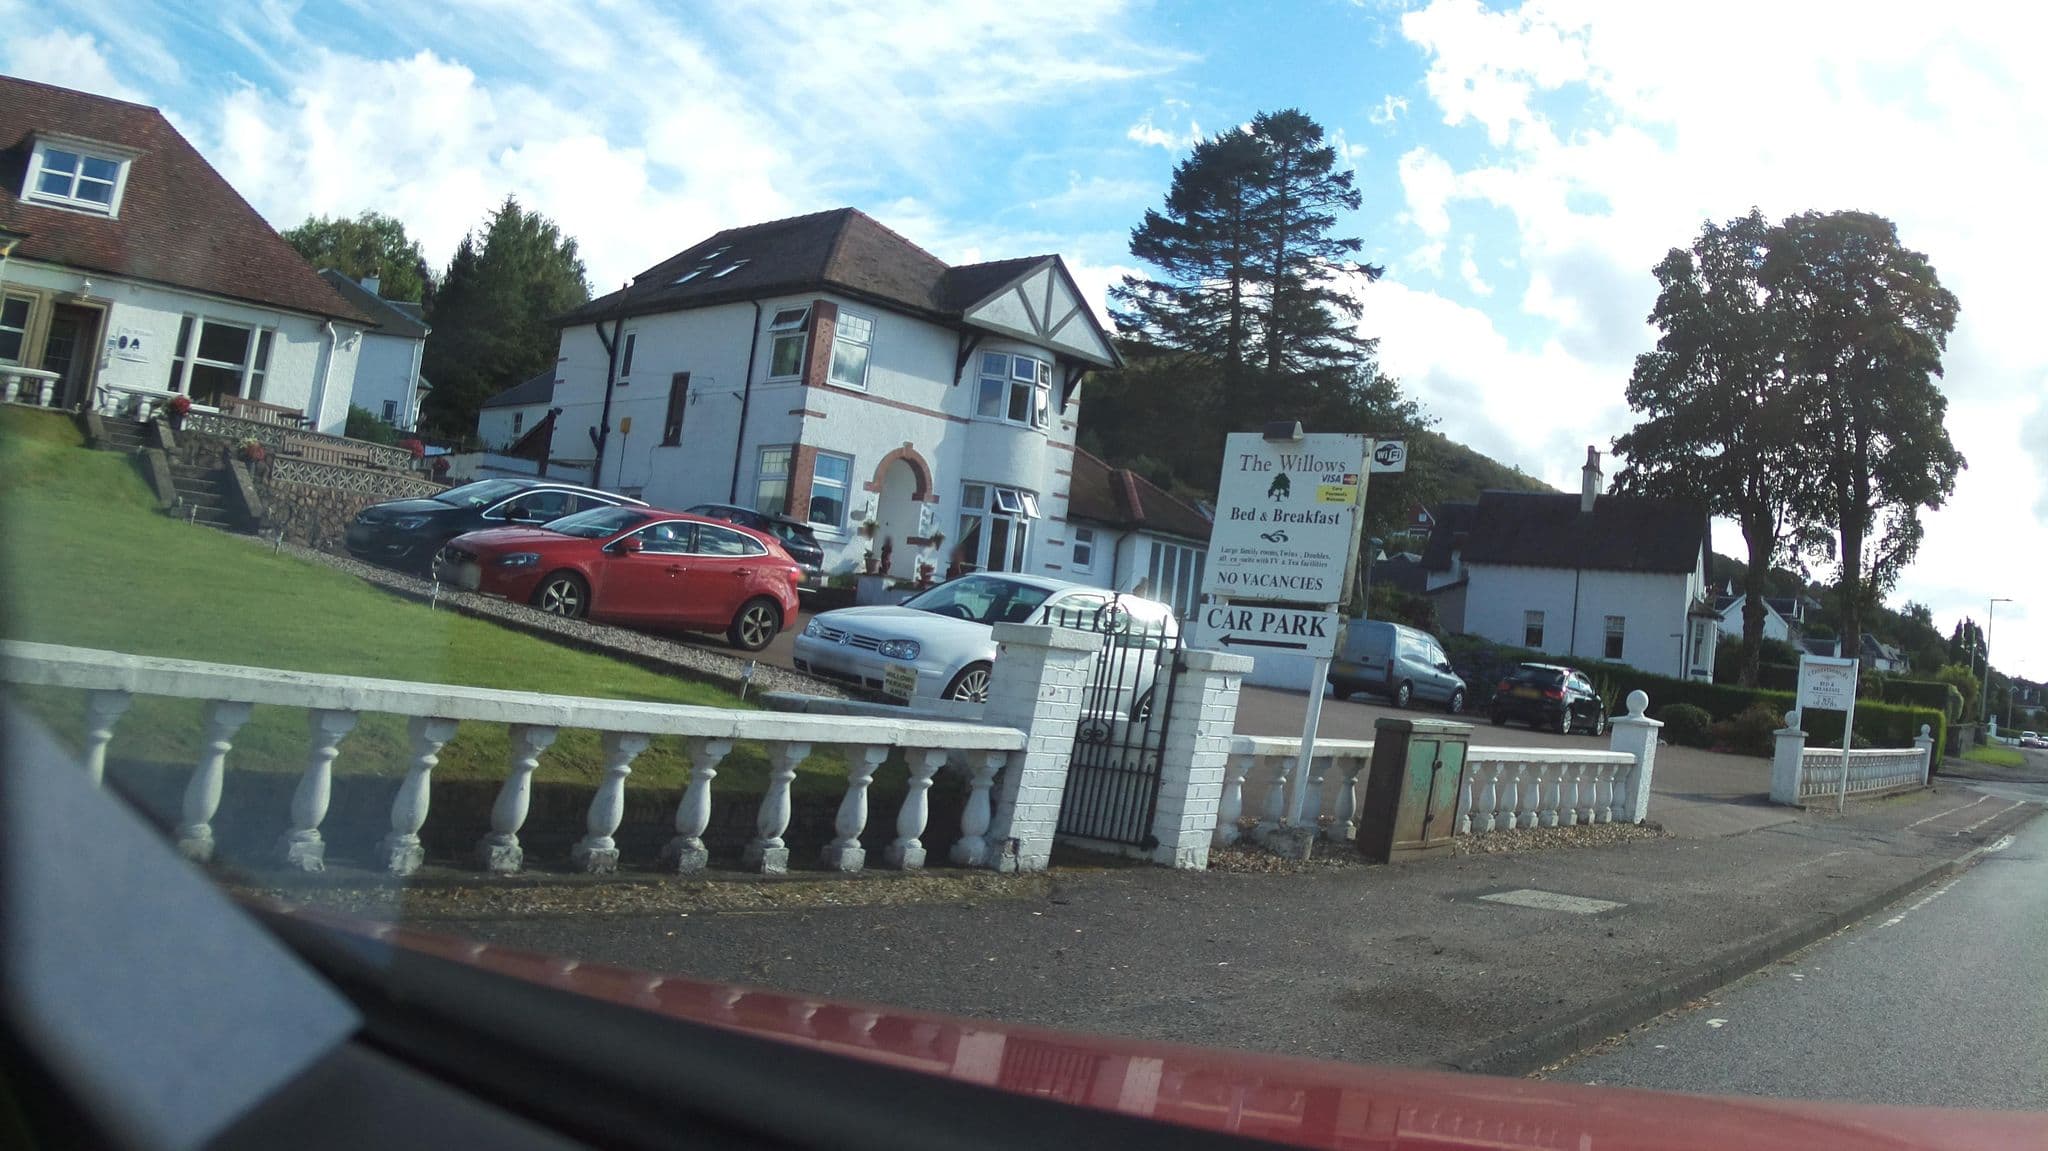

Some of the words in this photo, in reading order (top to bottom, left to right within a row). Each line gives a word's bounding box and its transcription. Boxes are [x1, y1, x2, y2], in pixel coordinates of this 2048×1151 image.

[1239, 454, 1272, 472] The
[1279, 454, 1347, 473] Willows
[1322, 474, 1341, 483] VISA
[1231, 507, 1257, 521] Bed
[1259, 511, 1268, 522] &
[1272, 508, 1340, 525] Breakfast
[1220, 545, 1239, 555] Large
[1240, 547, 1259, 556] family
[1300, 559, 1328, 568] facilities
[1217, 571, 1239, 585] NO
[1242, 573, 1324, 591] VACANCIES
[1206, 607, 1254, 632] CAR
[1259, 611, 1329, 638] PARK
